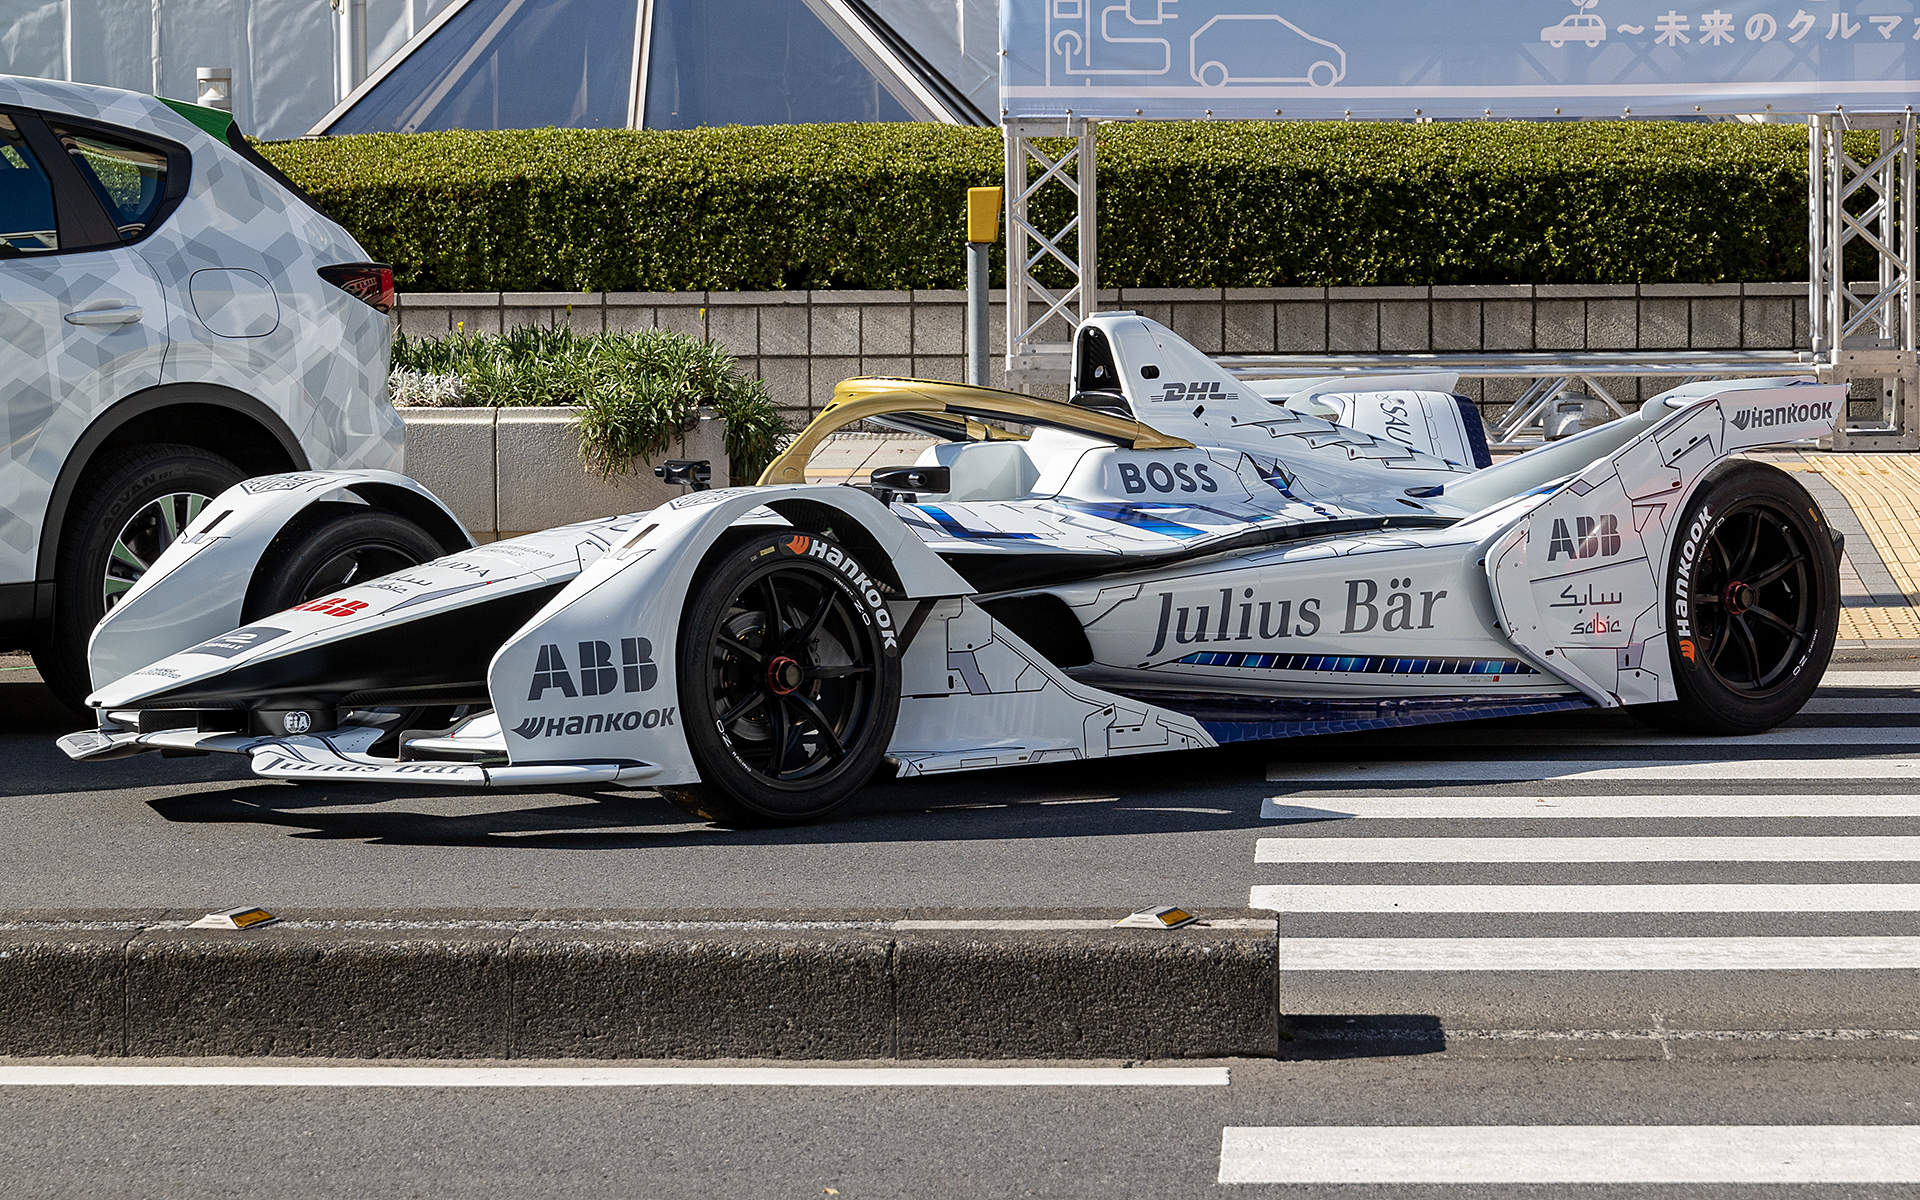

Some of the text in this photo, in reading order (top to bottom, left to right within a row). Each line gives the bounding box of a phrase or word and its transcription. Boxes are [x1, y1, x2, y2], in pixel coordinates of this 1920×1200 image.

[1616, 9, 1920, 47] ～未来のクルマ
[1162, 382, 1227, 401] DHL
[1380, 402, 1413, 448] SAU
[101, 473, 157, 528] ADVAN
[1118, 462, 1218, 494] BOSS
[1547, 514, 1621, 561] ABB
[1146, 577, 1447, 657] Julius Bär
[527, 636, 658, 701] ABB
